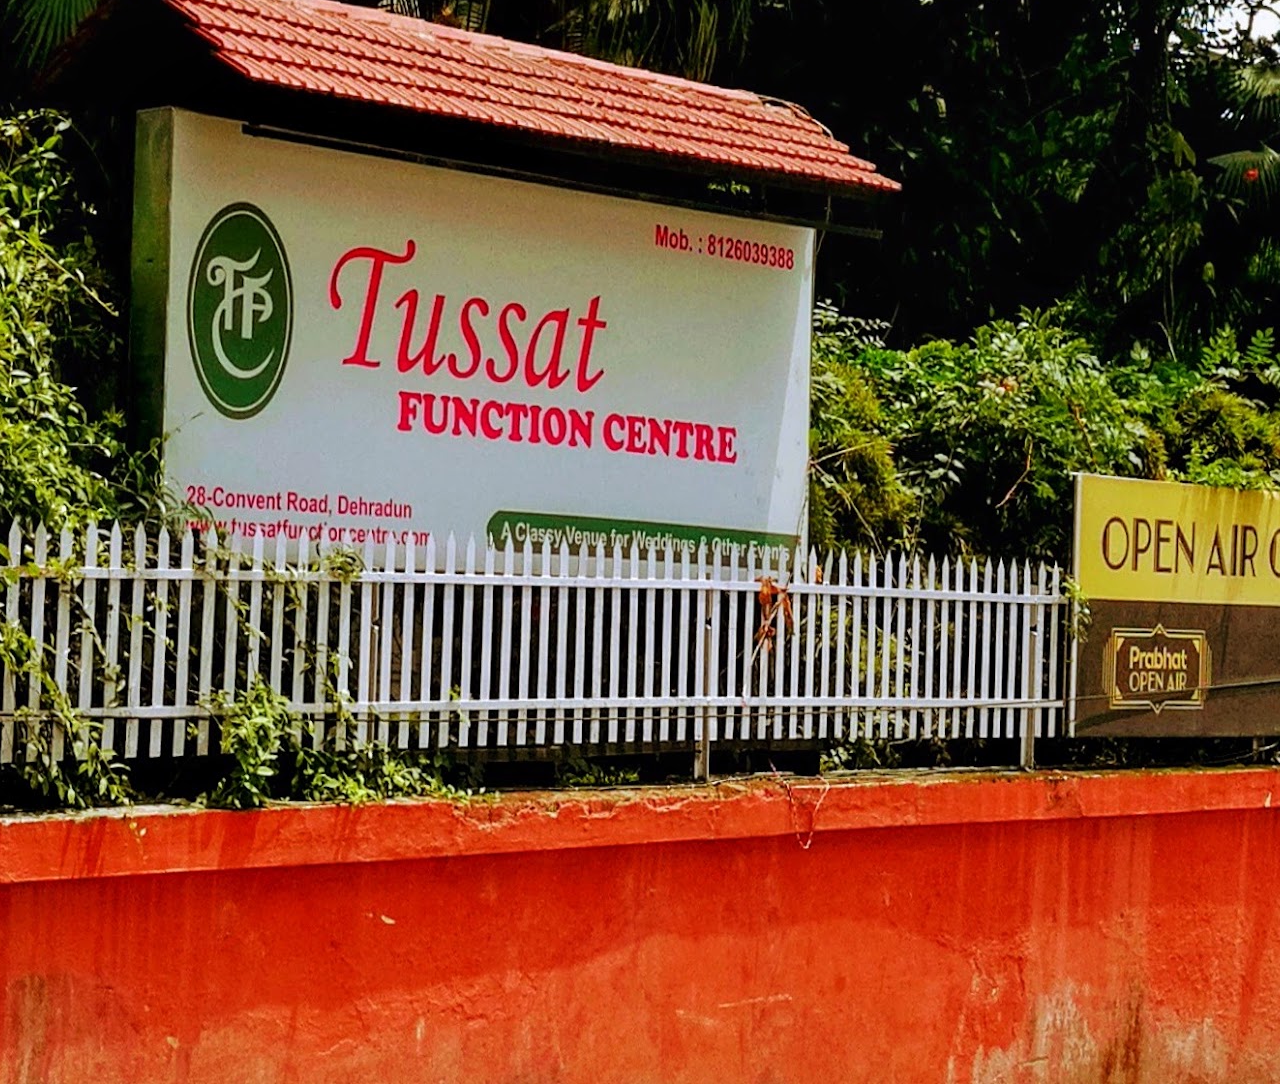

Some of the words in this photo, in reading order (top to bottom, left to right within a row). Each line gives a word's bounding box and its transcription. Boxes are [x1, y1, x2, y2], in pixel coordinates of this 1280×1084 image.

[655, 224, 693, 251] Mob.
[707, 234, 794, 270] 8126039388
[329, 239, 608, 393] Tussat
[397, 391, 595, 449] FUNCTION
[603, 412, 737, 465] CENTRE
[186, 485, 281, 511] 28-Convent
[287, 491, 332, 516] Road,
[337, 495, 412, 518] Dehradun
[500, 520, 512, 540] A
[515, 521, 562, 548] Classy
[566, 525, 608, 547] Venue
[610, 528, 630, 548] for
[1102, 516, 1196, 573] OPEN
[1206, 524, 1259, 577] AIR
[1129, 645, 1187, 670] Prabhat
[1129, 671, 1164, 693] OPEN
[1166, 671, 1187, 692] AIR
